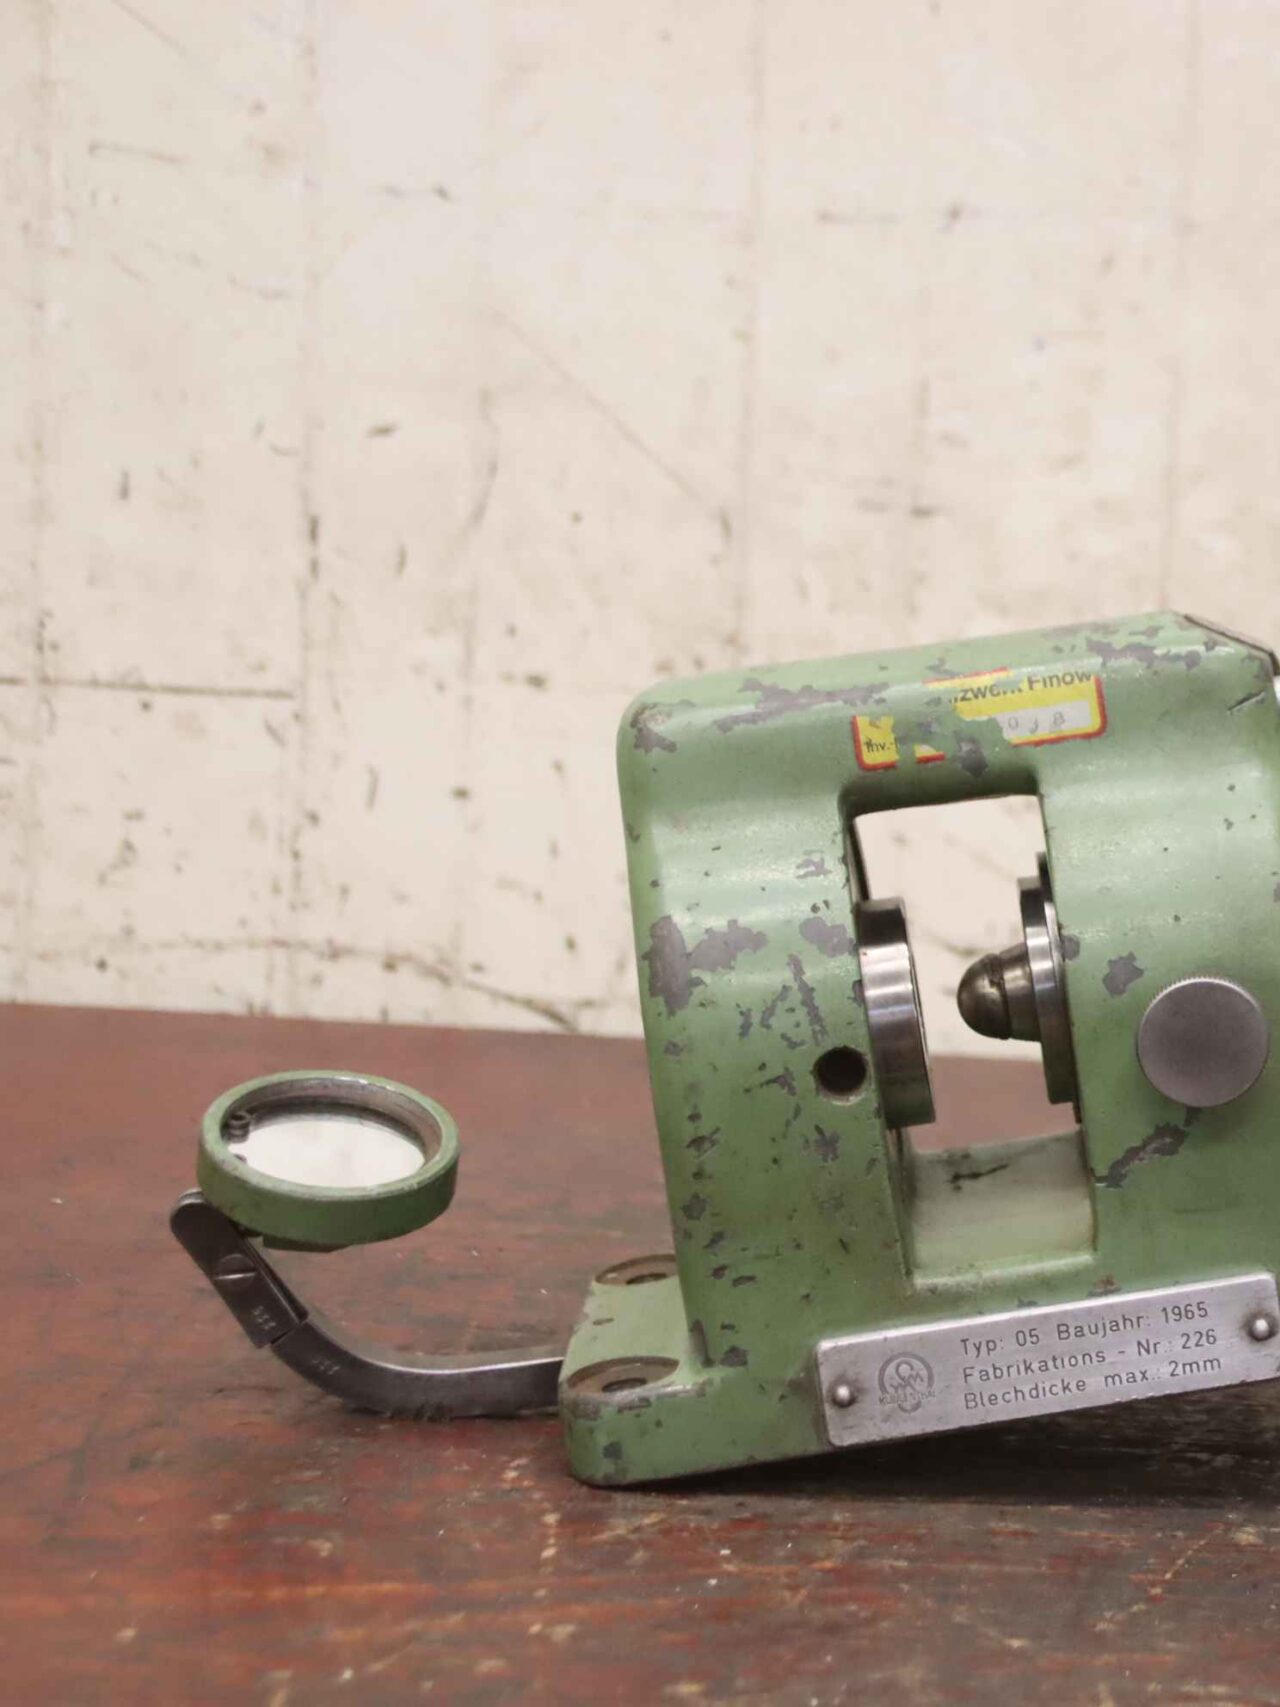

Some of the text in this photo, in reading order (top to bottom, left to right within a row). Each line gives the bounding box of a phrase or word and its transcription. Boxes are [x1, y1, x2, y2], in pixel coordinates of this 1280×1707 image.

[960, 1301, 1208, 1358] Typ: 05 Baujahr: 1965
[963, 1350, 1106, 1384] Fabrikations
[1180, 1328, 1217, 1350] 226
[964, 1378, 1087, 1410] Blechdicke
[1168, 1357, 1222, 1377] 2mm
